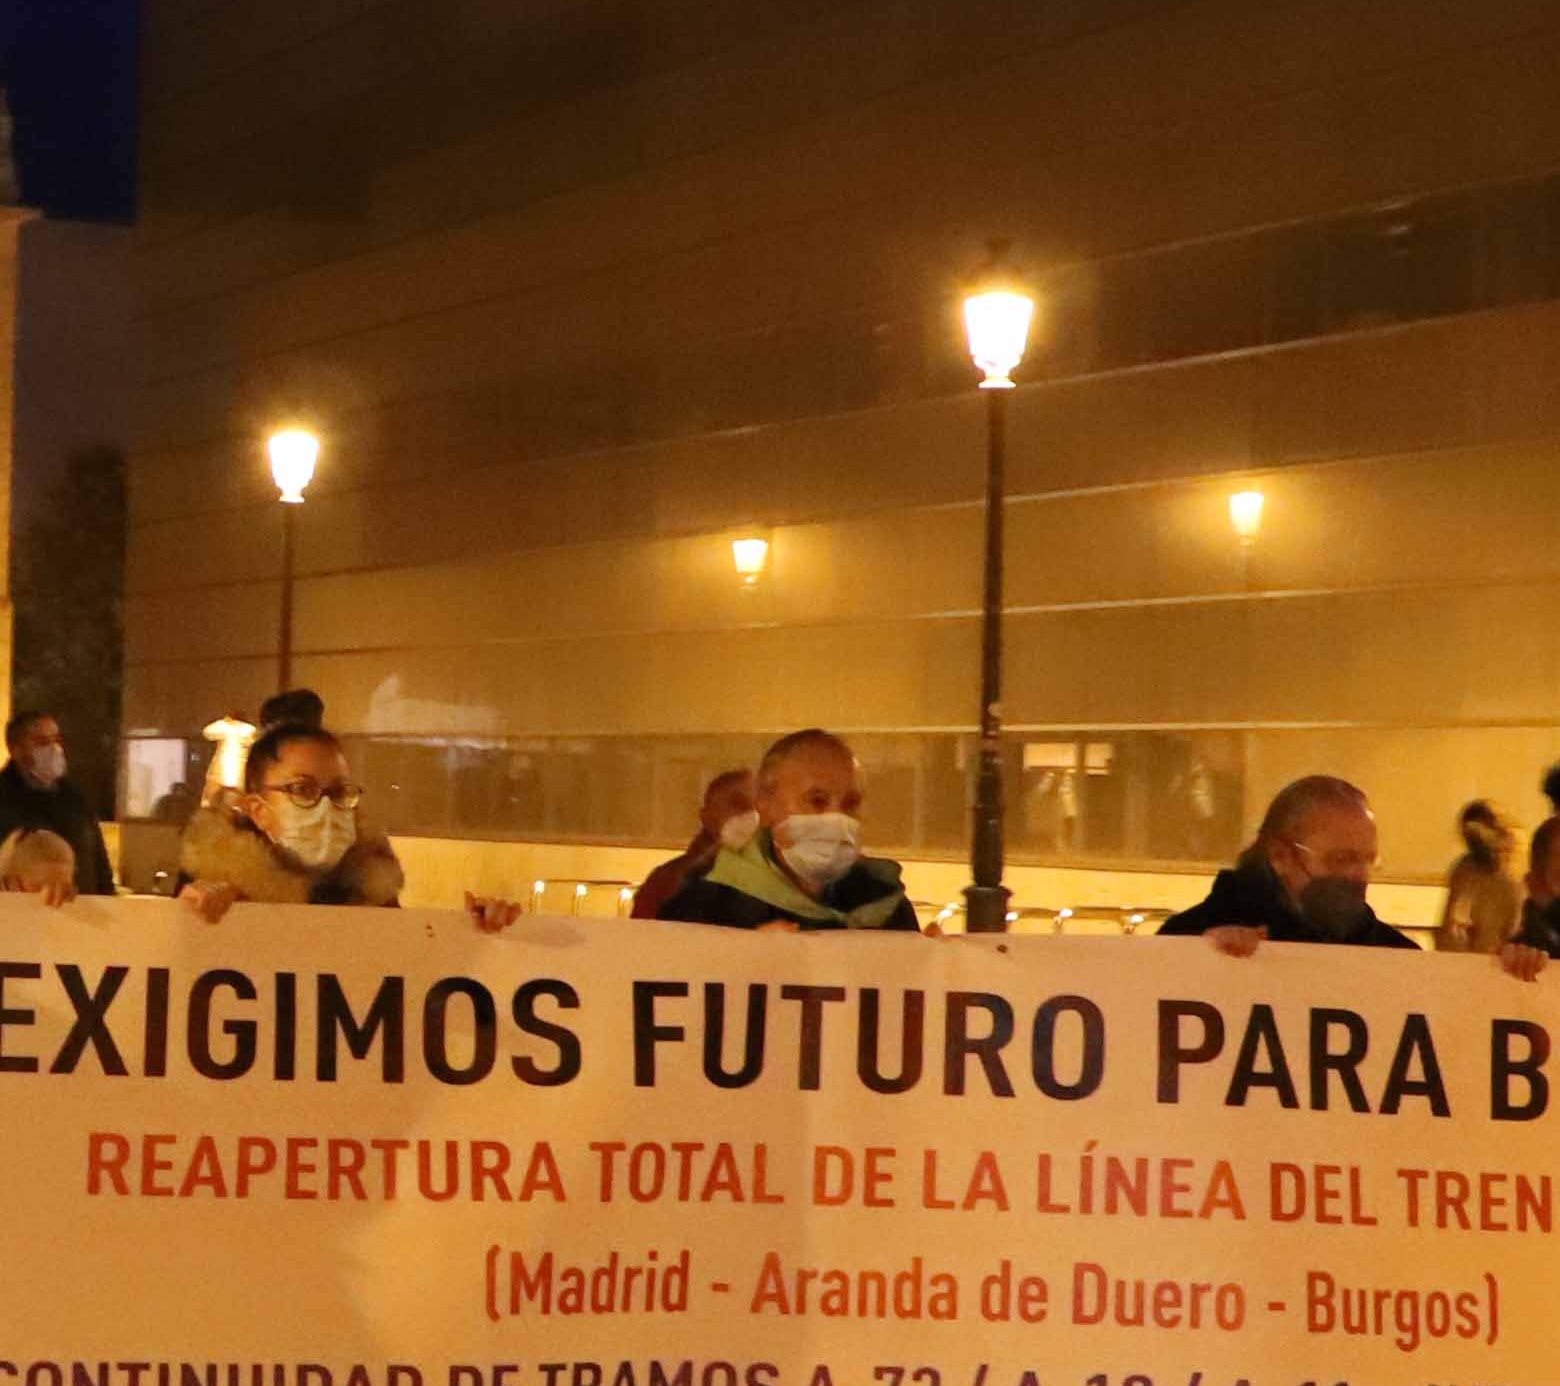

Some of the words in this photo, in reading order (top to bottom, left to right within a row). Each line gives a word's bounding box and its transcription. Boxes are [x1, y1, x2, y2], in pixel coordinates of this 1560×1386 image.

[631, 979, 1107, 1102] FUTURO
[1156, 998, 1453, 1119] PARA
[86, 1132, 567, 1203] REAPERTURA
[589, 1141, 785, 1205] TOTAL
[812, 1145, 897, 1208] DE
[922, 1148, 1010, 1212] LA
[1037, 1140, 1247, 1221] LÍNEA
[1269, 1161, 1379, 1227] DEL
[1396, 1168, 1553, 1234] TREN
[485, 1244, 691, 1323] (Madrid
[749, 1251, 959, 1321] Aranda
[980, 1259, 1049, 1324] de
[1071, 1262, 1246, 1332] Duero
[1306, 1270, 1499, 1353] Burgos)
